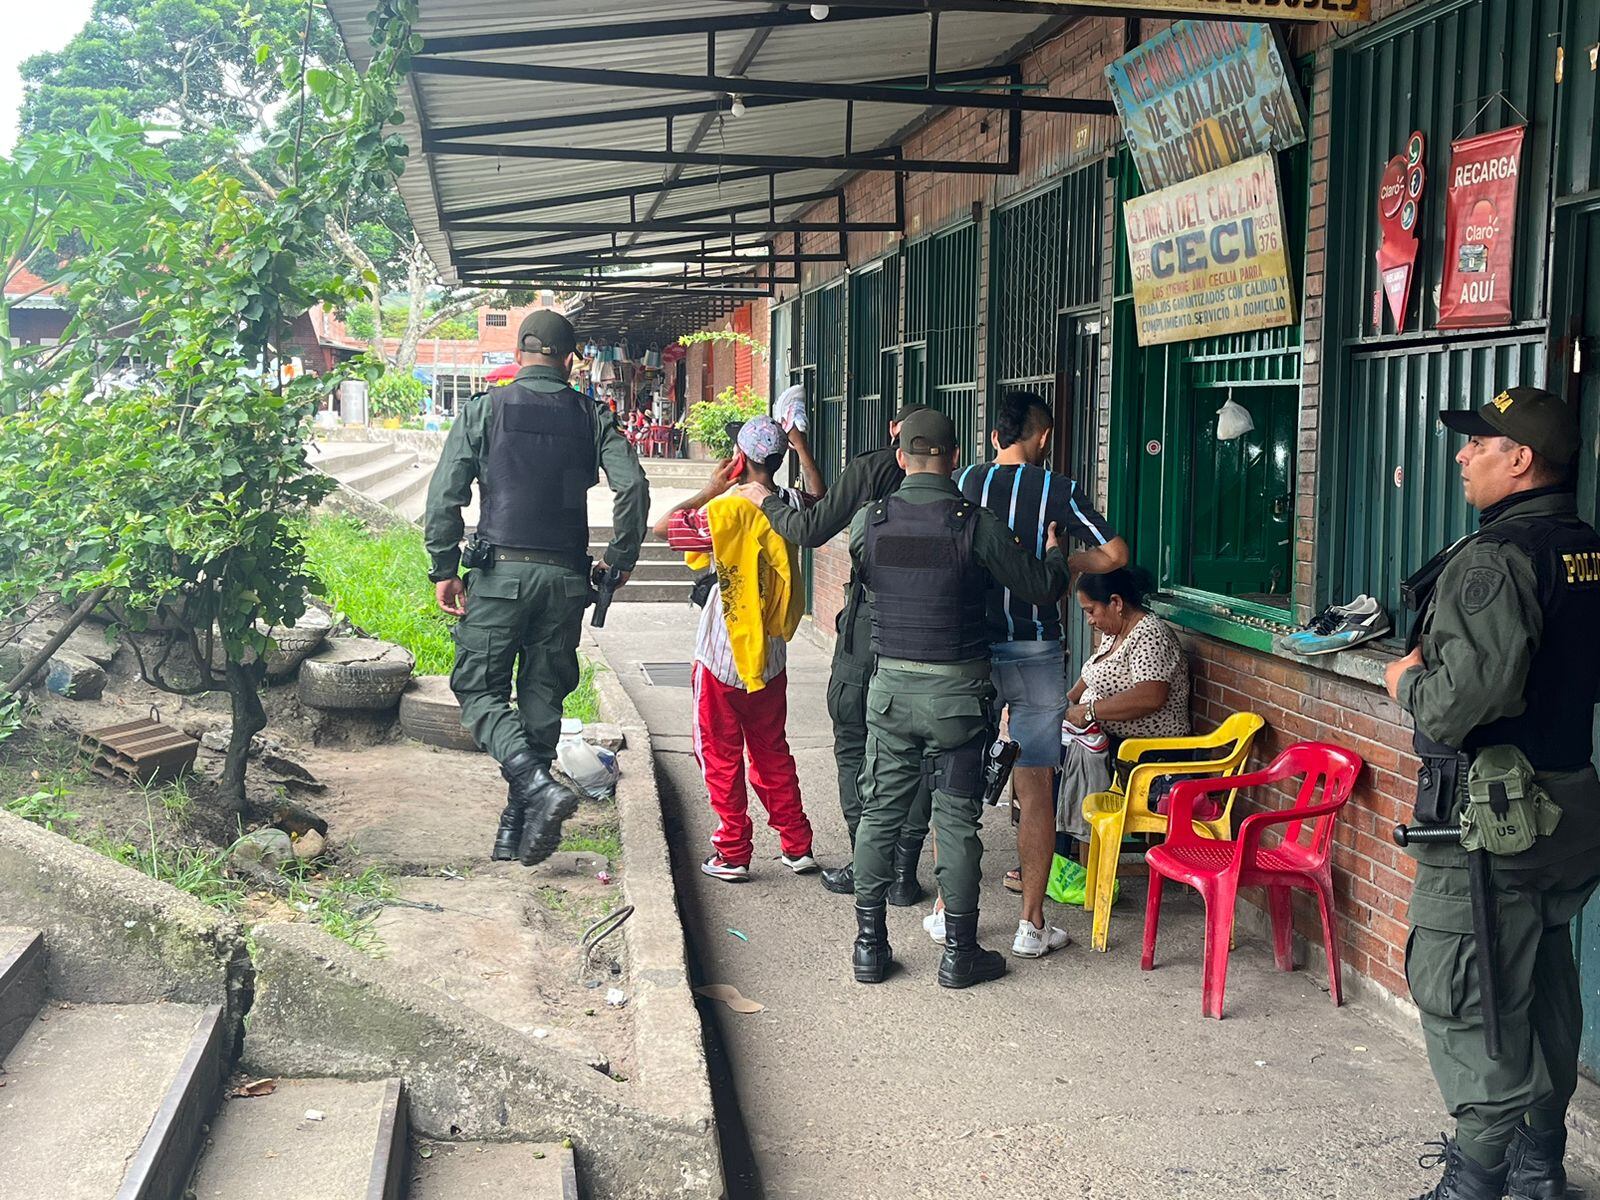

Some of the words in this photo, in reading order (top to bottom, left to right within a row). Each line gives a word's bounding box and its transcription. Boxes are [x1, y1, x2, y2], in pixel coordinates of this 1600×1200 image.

[1145, 99, 1172, 143] DE
[1173, 57, 1257, 129] CALZADO
[1136, 152, 1162, 192] LA
[1158, 124, 1221, 185] PUERTA
[1218, 105, 1263, 162] DEL
[1260, 87, 1303, 144] SOL
[1454, 155, 1518, 188] RECARGA
[1380, 180, 1402, 200] Claro
[1128, 201, 1175, 244] CLINICA
[1175, 192, 1206, 231] DEL
[1207, 168, 1274, 222] CALZADO
[1258, 232, 1278, 251] 376
[1465, 220, 1496, 242] Claro
[1151, 217, 1258, 279] CECI
[1135, 264, 1151, 281] 376
[1208, 269, 1237, 287] CECILIA
[1239, 263, 1263, 281] PARRA
[1138, 300, 1172, 318] TRABAJOS
[1172, 289, 1226, 311] GARANTIZADOS
[1227, 283, 1244, 301] CON
[1245, 277, 1278, 297] CALIDAD
[1279, 275, 1286, 290] Y
[1460, 273, 1496, 304] AQUÍ
[1194, 306, 1230, 325] SERVICIO
[1233, 304, 1240, 318] A
[1244, 296, 1286, 316] DOMICILIO
[1496, 825, 1517, 837] US
